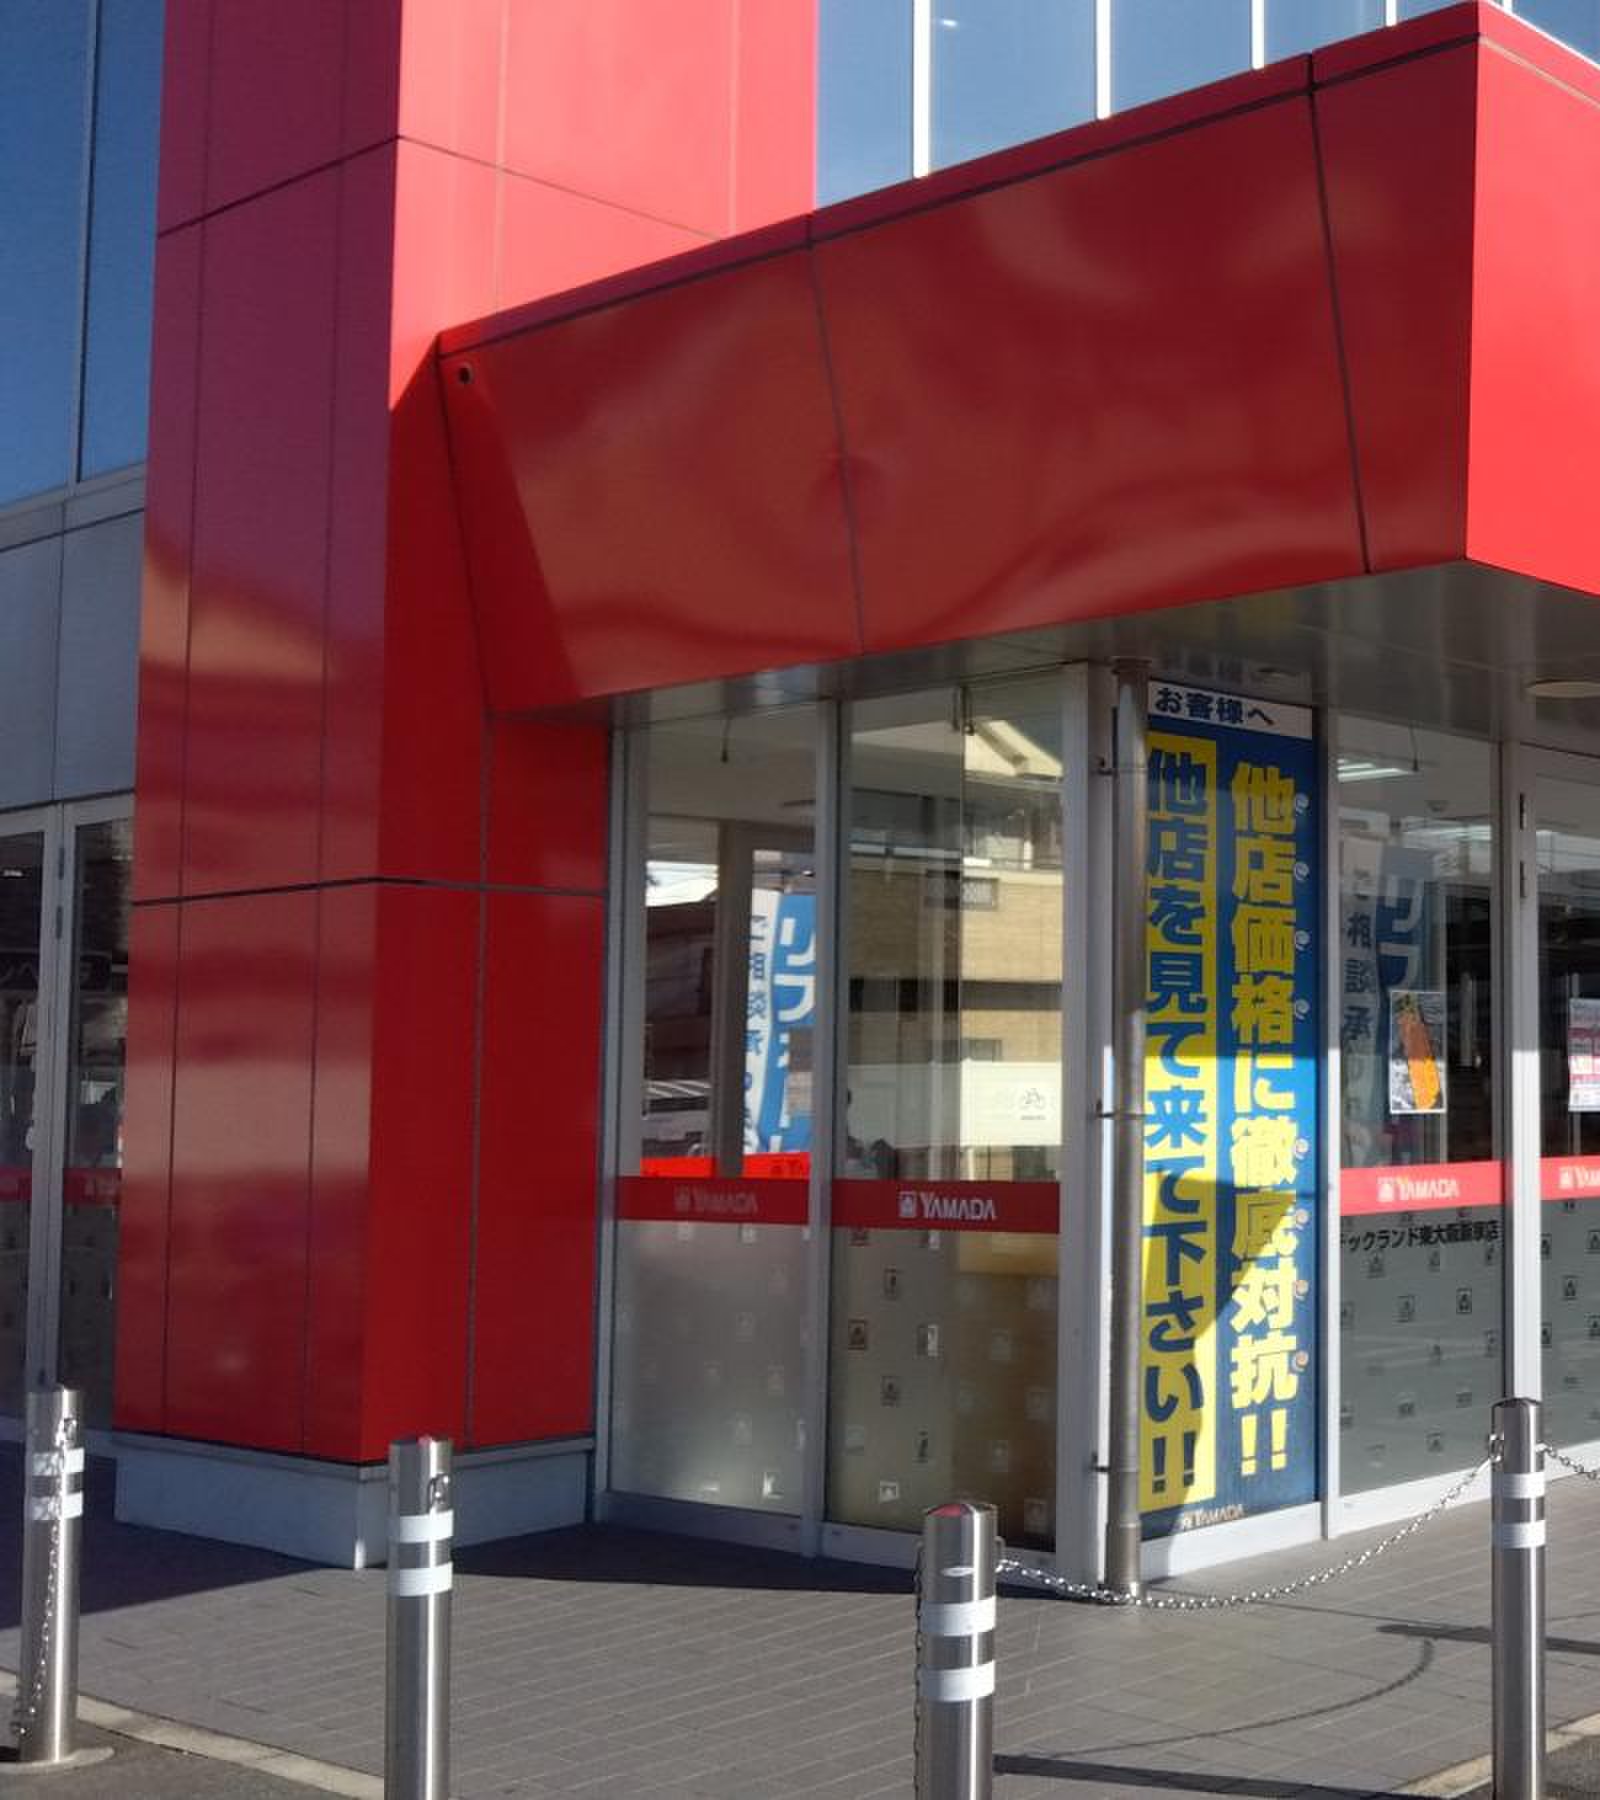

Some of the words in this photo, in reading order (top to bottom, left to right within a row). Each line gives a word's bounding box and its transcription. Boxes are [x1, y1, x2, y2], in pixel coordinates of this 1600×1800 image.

[1155, 687, 1274, 726] お客様へ
[920, 1193, 996, 1221] YAMADA
